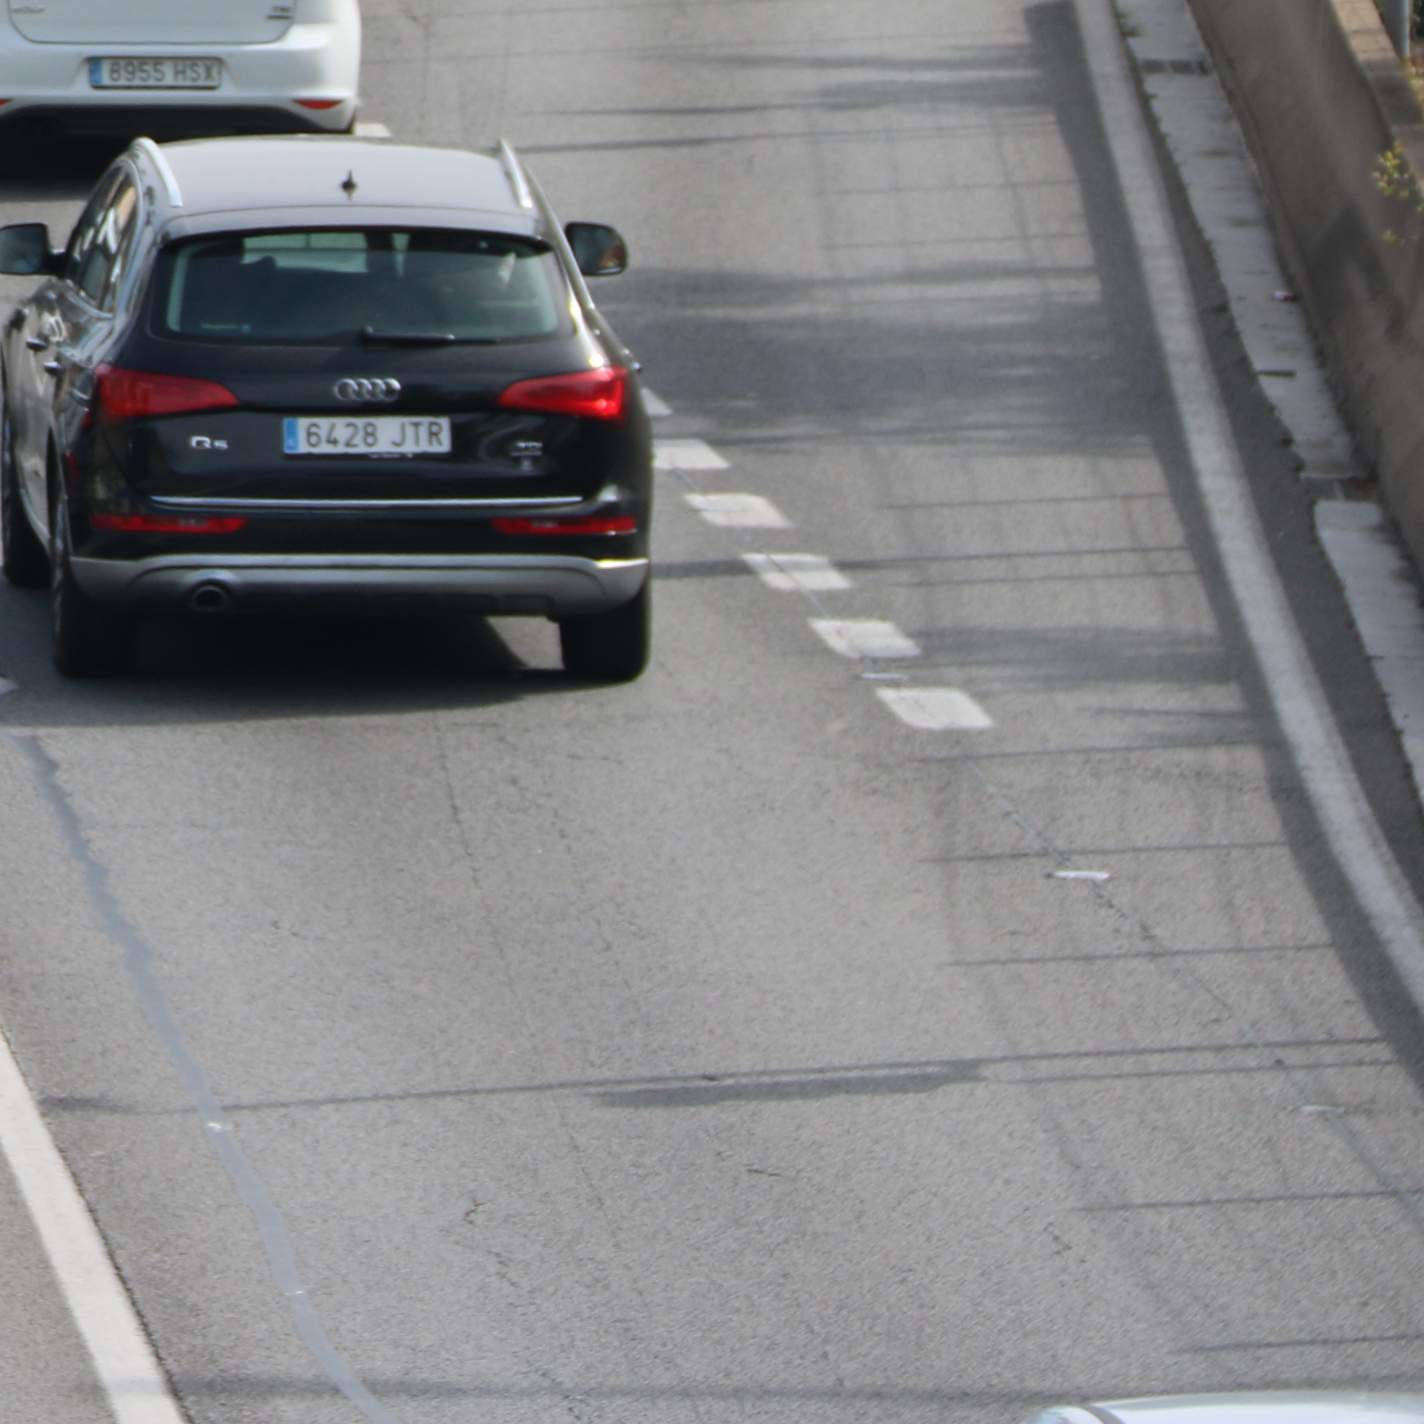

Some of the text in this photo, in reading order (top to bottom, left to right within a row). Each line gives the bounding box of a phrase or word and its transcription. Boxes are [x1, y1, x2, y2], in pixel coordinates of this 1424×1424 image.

[109, 62, 214, 83] 8955 HSX
[305, 421, 444, 448] 6428 JTR
